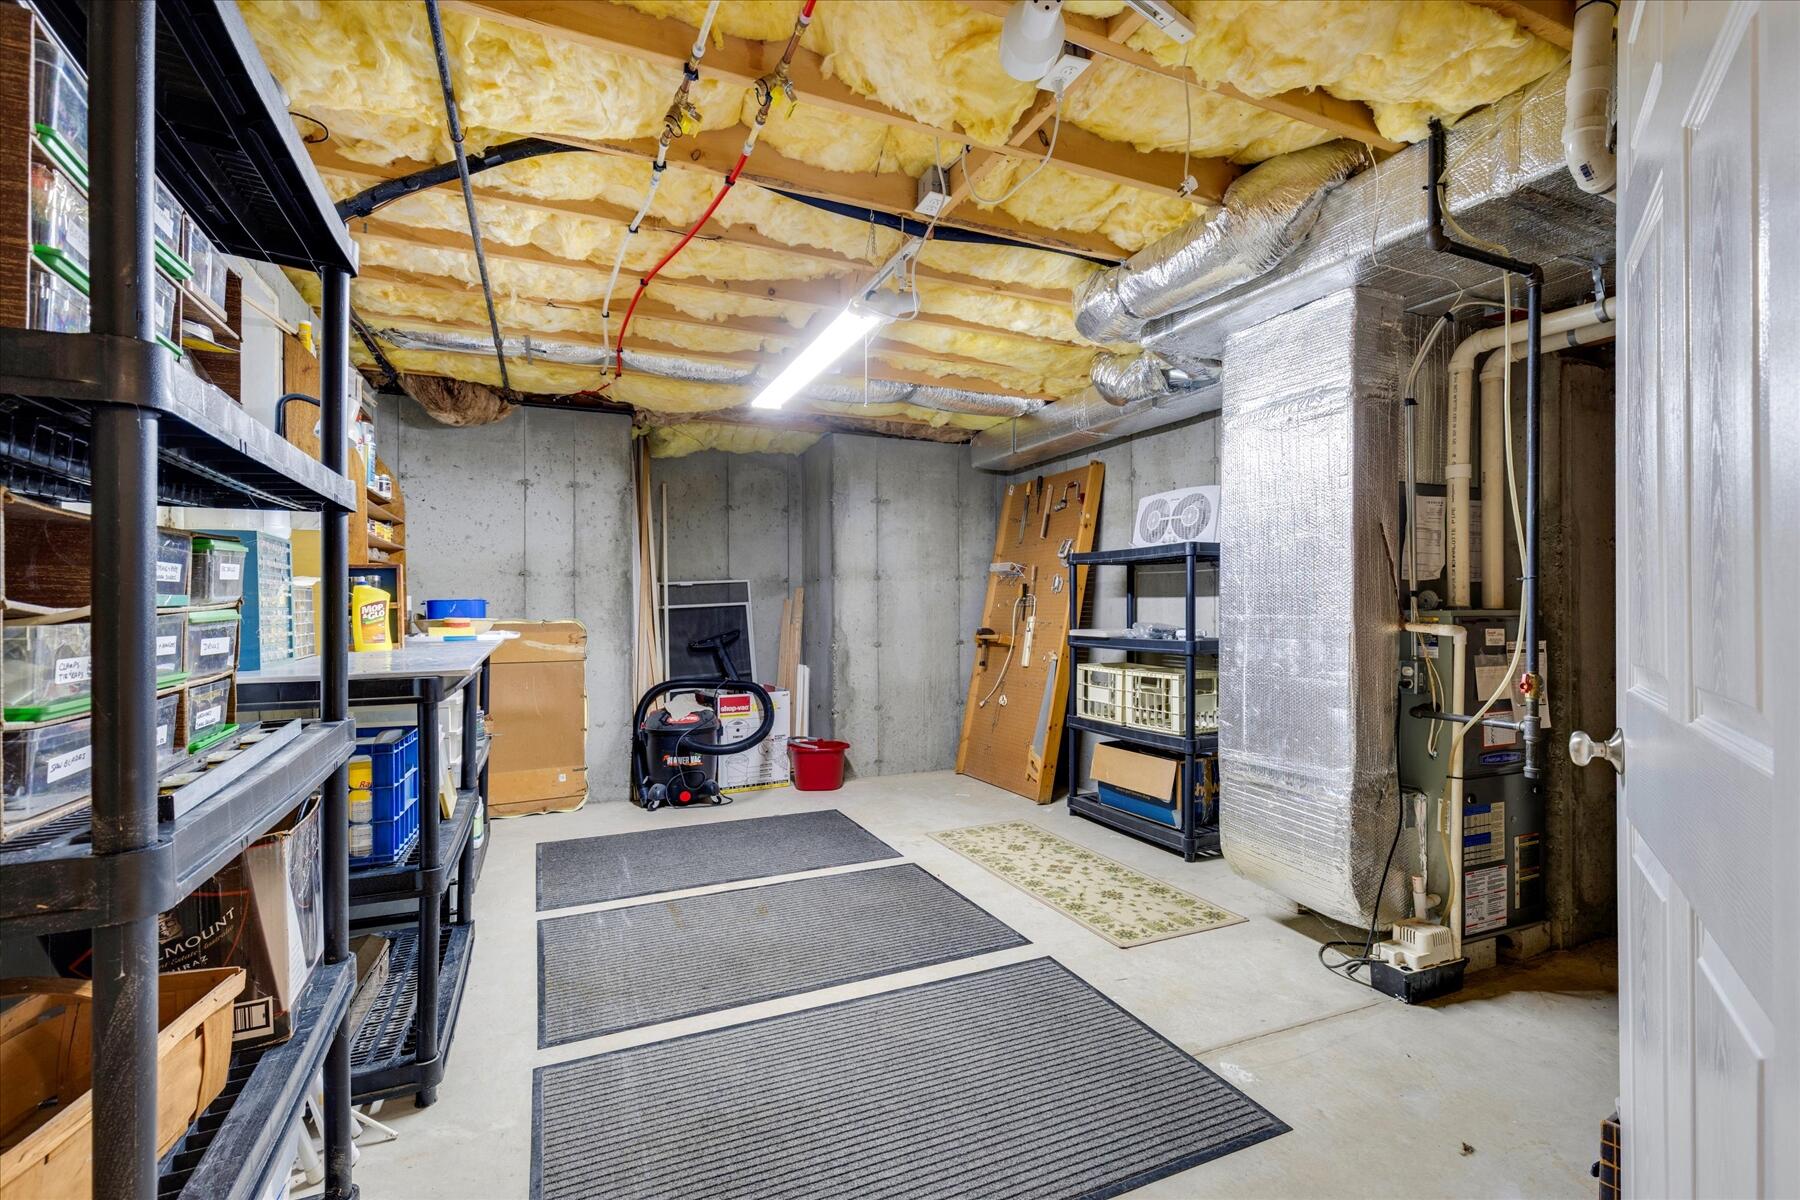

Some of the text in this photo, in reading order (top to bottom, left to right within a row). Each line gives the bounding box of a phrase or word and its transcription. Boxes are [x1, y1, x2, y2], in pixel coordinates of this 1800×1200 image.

[362, 603, 384, 614] MOP
[720, 704, 750, 713] shop-vac
[158, 907, 234, 960] MOUNT
